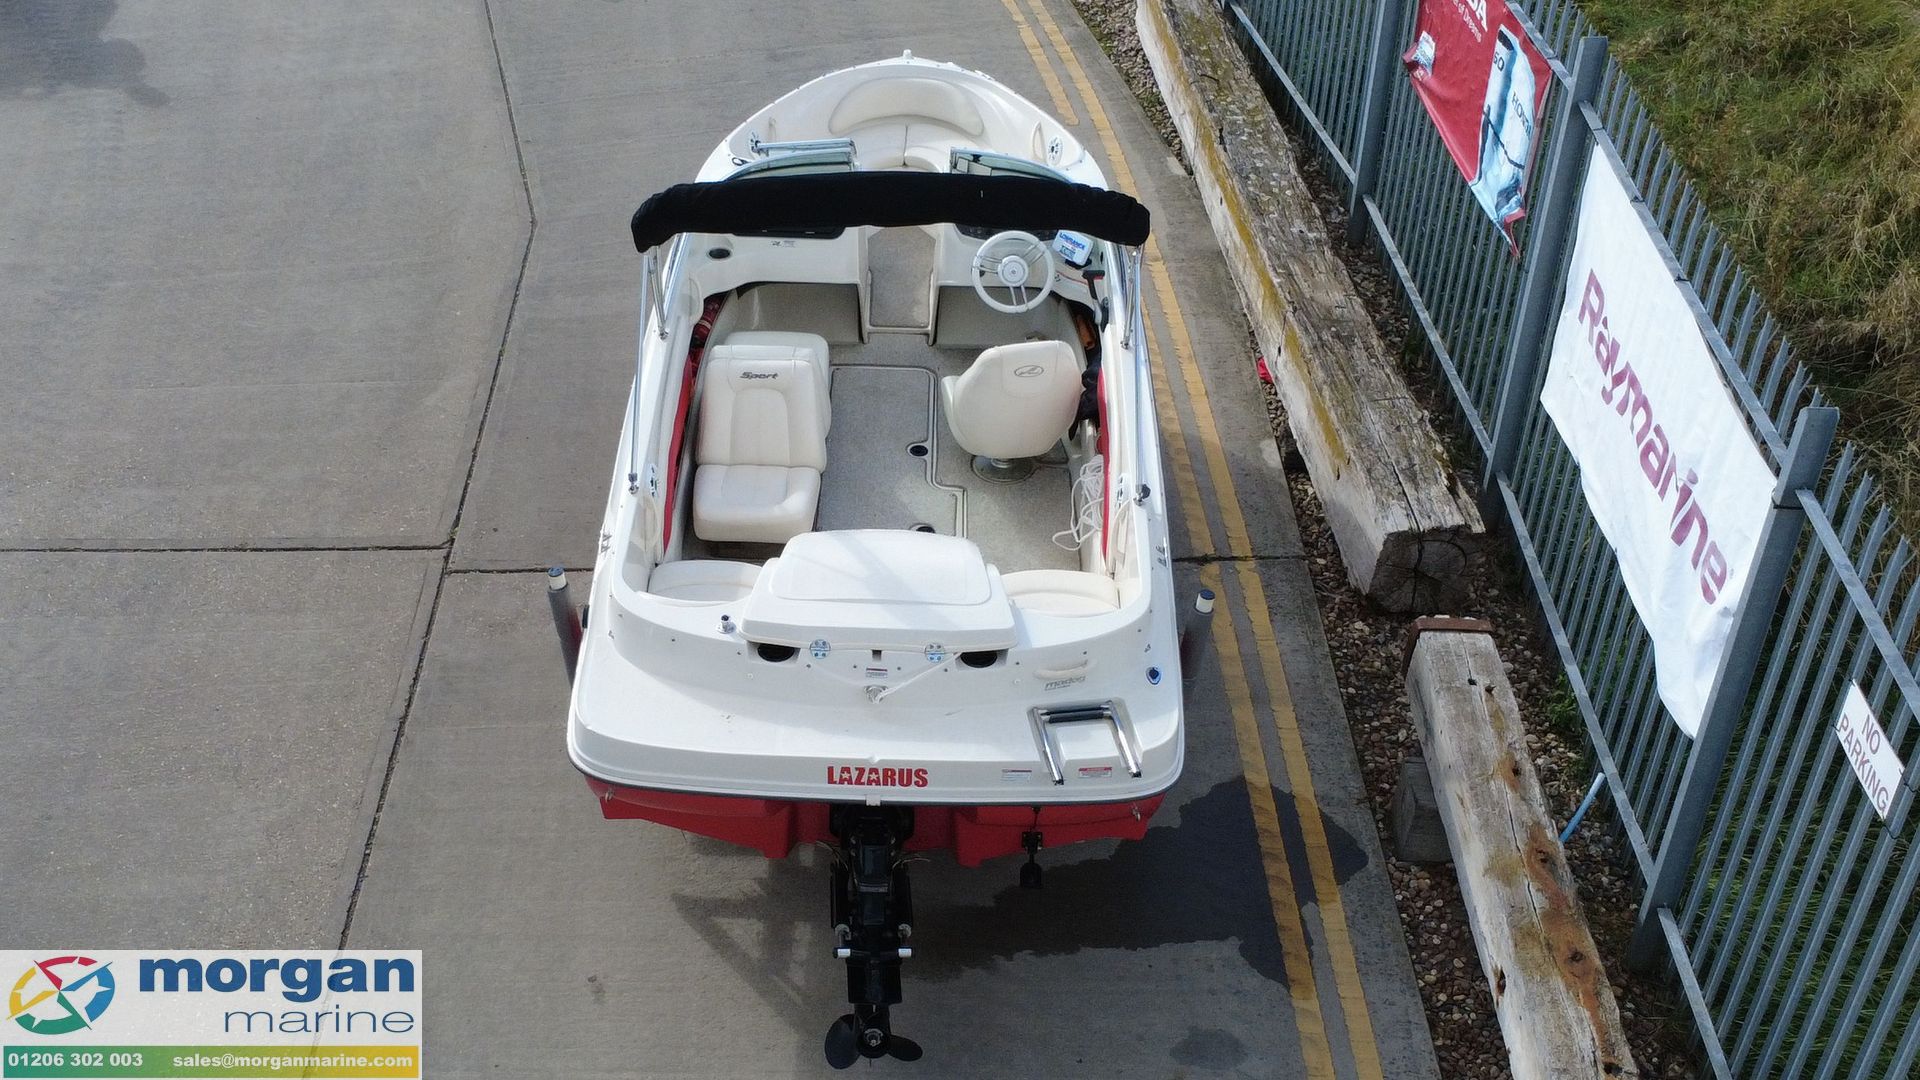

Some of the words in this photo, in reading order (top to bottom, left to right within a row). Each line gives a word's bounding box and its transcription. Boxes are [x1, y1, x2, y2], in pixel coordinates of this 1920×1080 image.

[739, 371, 779, 380] Sport
[1577, 267, 1728, 605] Raymarine
[1861, 714, 1881, 755] NO
[827, 765, 929, 788] LAZARUS
[1839, 712, 1889, 812] PARKING
